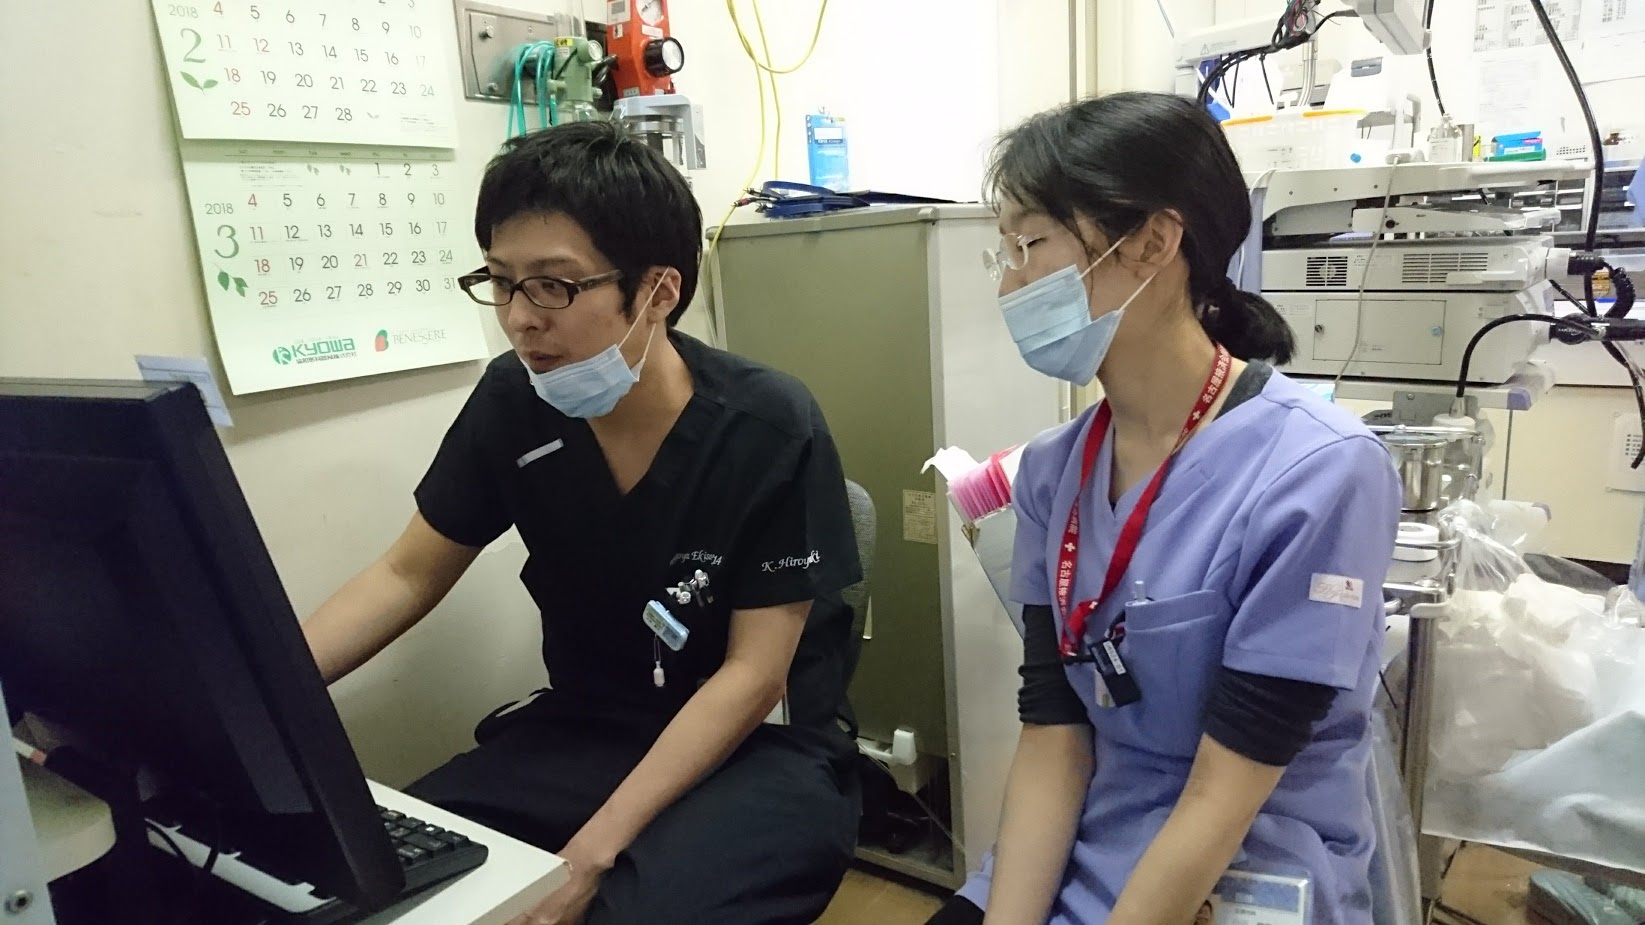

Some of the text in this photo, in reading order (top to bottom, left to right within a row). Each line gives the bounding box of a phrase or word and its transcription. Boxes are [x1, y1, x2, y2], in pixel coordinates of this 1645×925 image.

[167, 3, 199, 19] 2018
[213, 0, 422, 39] 4 5 6 7 8 9 10
[180, 27, 207, 64] 2
[216, 33, 427, 68] 11 12 13 14 15 16 17
[224, 67, 435, 97] 18 19 20 21 22 23 24
[230, 100, 353, 122] 25 26 27 28
[374, 162, 440, 177] 1 2 3
[204, 202, 234, 215] 2018
[247, 192, 445, 208] 4 5 6 7 8 9 10
[214, 224, 240, 259] 3
[250, 220, 448, 241] 11 12 13 14 15 16 17
[255, 249, 453, 273] 18 19 20 21 22 23 24
[258, 277, 456, 305] 25 26 27 28 29 30 31
